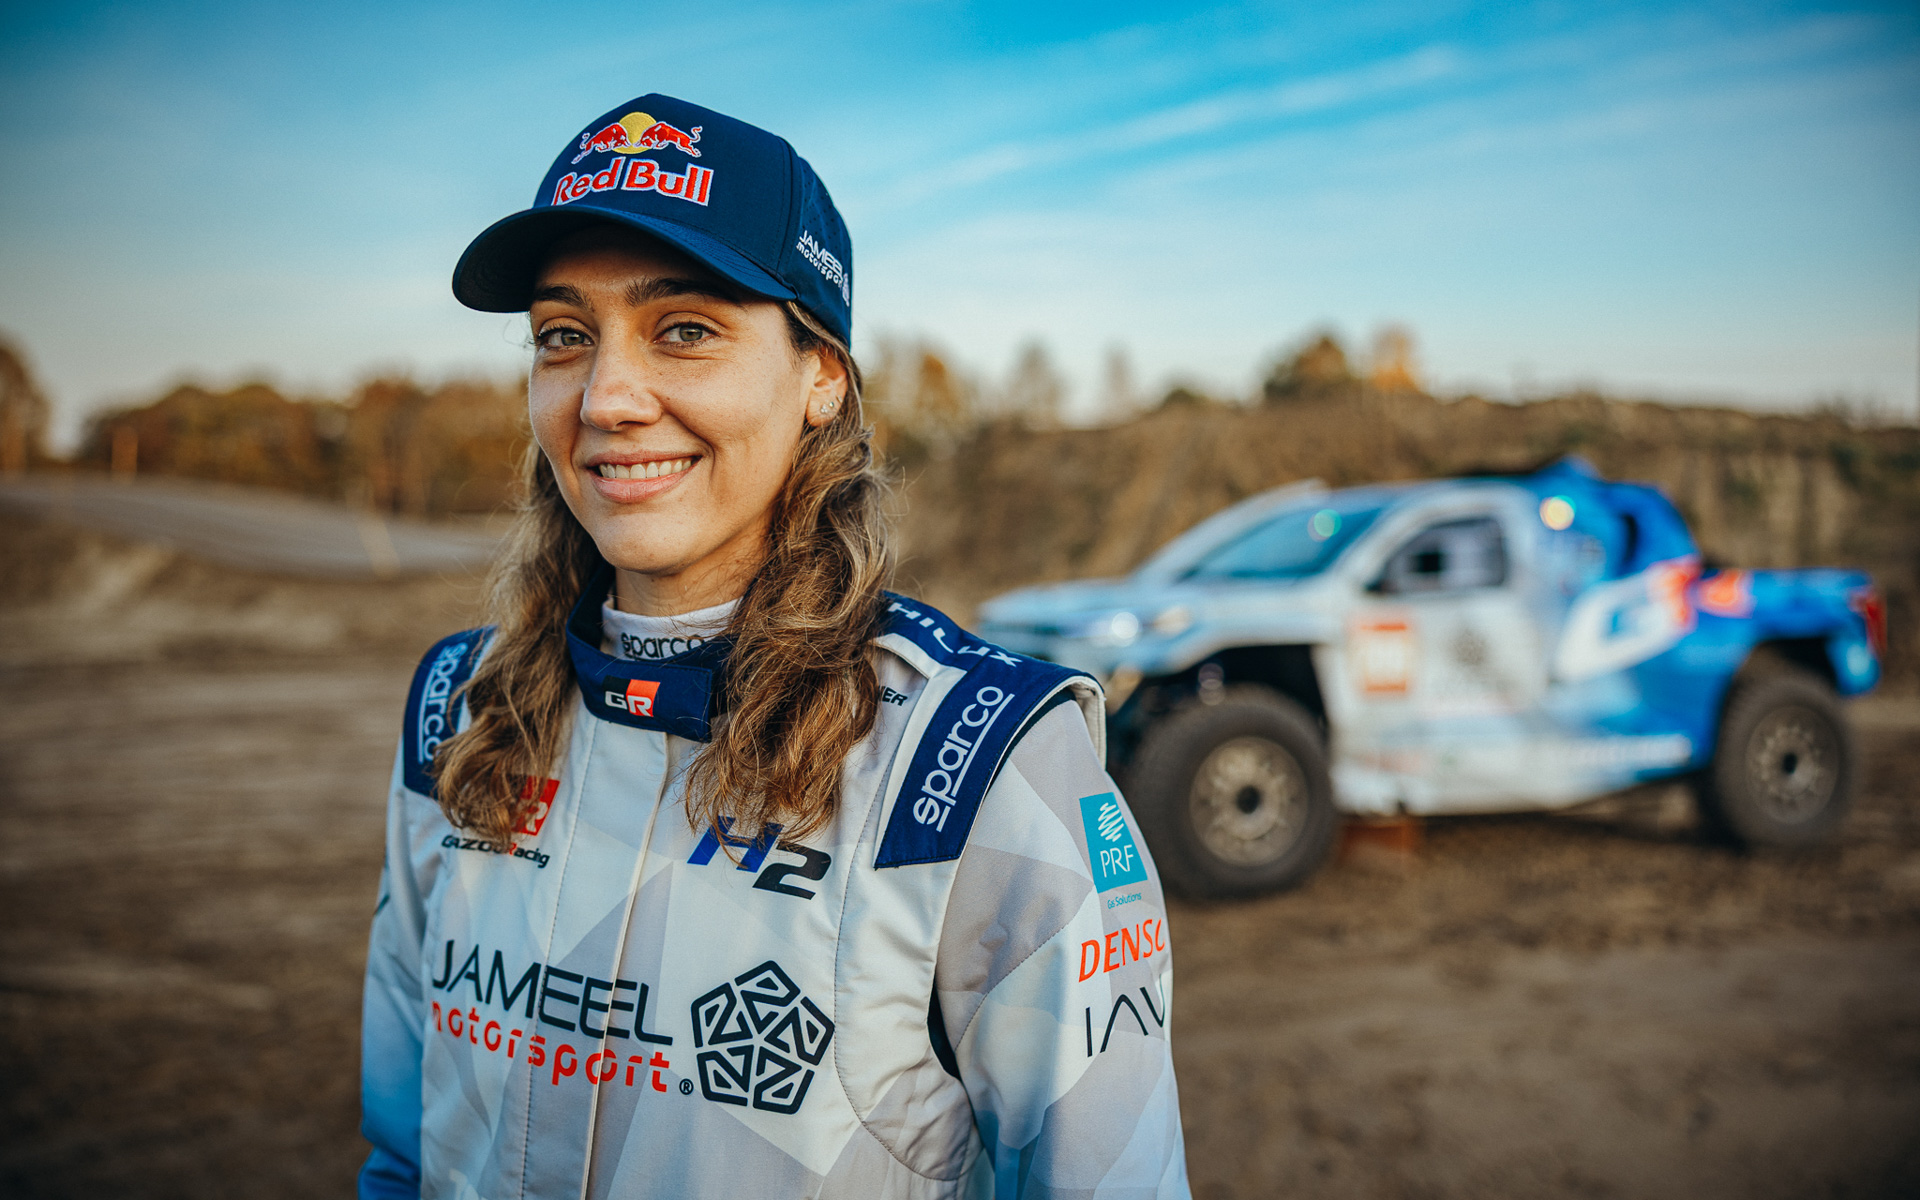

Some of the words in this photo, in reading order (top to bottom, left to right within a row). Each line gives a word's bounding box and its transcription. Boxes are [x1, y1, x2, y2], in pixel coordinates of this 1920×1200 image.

[551, 156, 626, 206] Red
[620, 158, 714, 207] Bull
[621, 632, 705, 660] sparco
[420, 642, 468, 762] sparco
[604, 690, 655, 717] GR
[913, 685, 1006, 828] sparco
[687, 816, 832, 901] H2
[1100, 844, 1135, 878] PRF
[1115, 892, 1142, 906] Solutions
[432, 938, 673, 1046] JAMEEL
